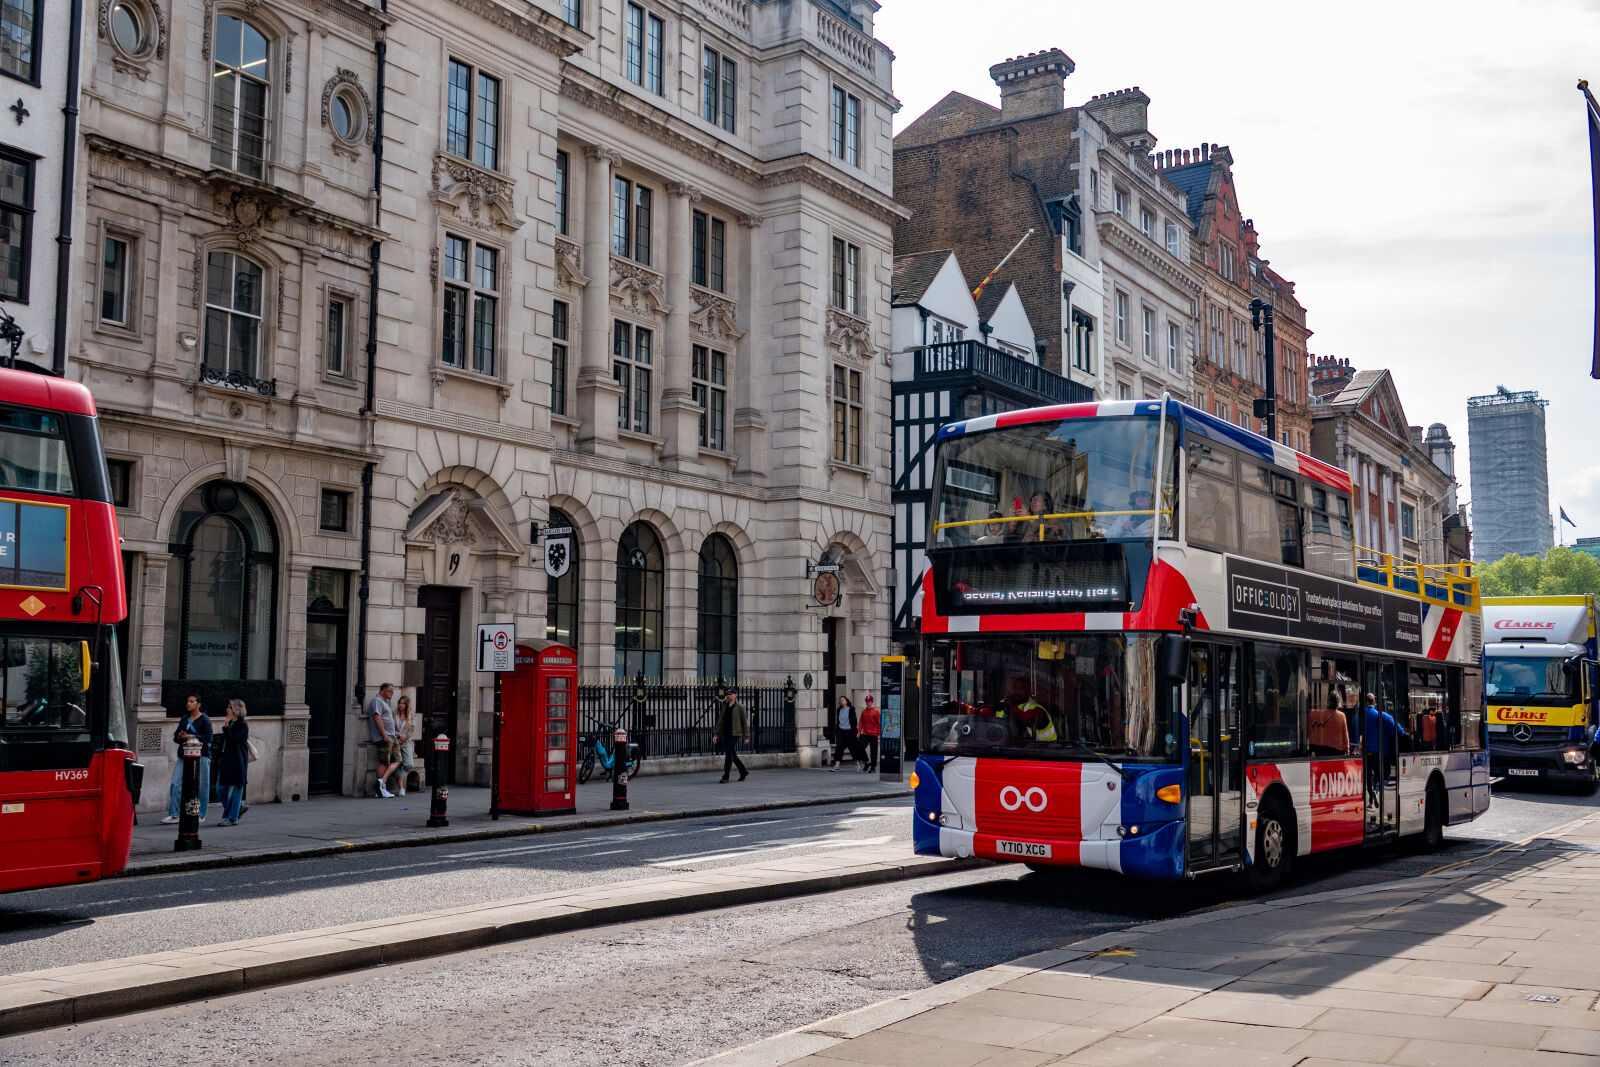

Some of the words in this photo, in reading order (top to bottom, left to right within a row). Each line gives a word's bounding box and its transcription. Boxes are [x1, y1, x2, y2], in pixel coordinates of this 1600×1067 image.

[449, 553, 460, 576] 19
[1128, 601, 1136, 611] 7
[1494, 619, 1556, 630] CLARKE
[1497, 707, 1548, 722] CLARKE
[55, 769, 89, 781] HV369
[1312, 770, 1362, 800] LONDON
[1001, 841, 1023, 854] YT10
[1025, 843, 1046, 856] XCG
